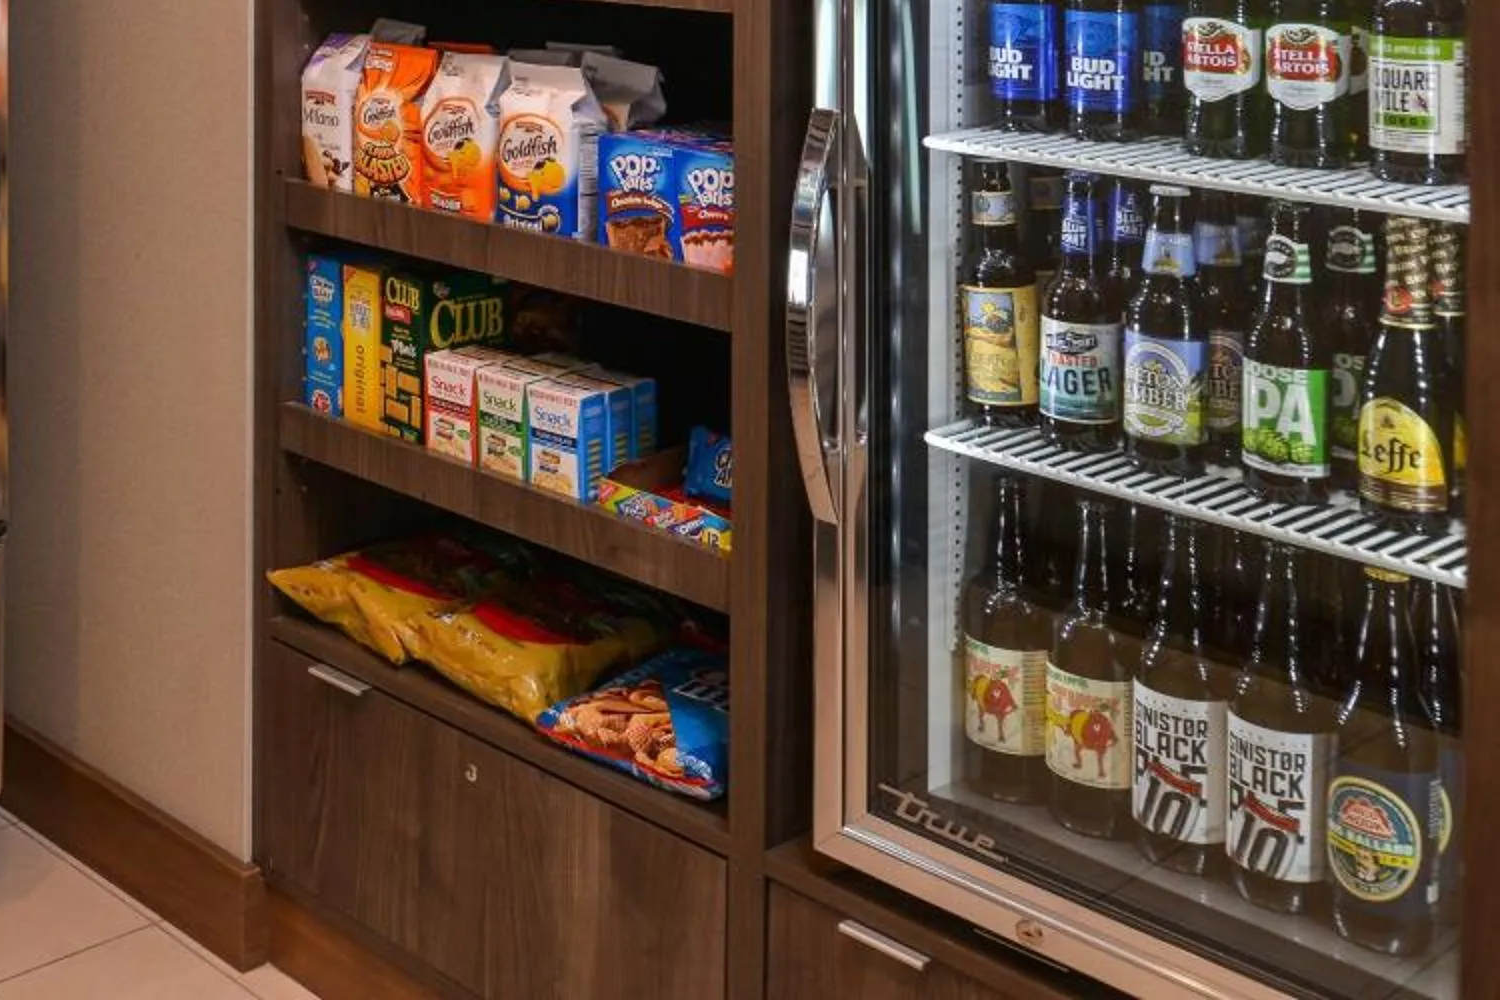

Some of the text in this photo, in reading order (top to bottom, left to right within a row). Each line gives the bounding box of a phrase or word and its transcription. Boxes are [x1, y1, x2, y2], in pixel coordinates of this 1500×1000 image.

[1071, 56, 1116, 73] BUD
[1275, 47, 1329, 64] STELLA
[1276, 61, 1331, 75] ARTOIS
[1067, 72, 1125, 90] LIGHT
[428, 117, 475, 146] Goldfish
[502, 134, 558, 163] Goldfish
[385, 276, 420, 312] CLUB
[429, 297, 504, 349] CLUB
[432, 374, 468, 393] Snack
[1040, 366, 1112, 396] LAGER
[483, 390, 517, 412] Snack
[1245, 376, 1317, 447] PA
[534, 405, 571, 429] Snack
[1361, 430, 1423, 474] Leffe
[1135, 718, 1208, 765] BLACK
[1229, 750, 1306, 801] BLACK
[877, 782, 1009, 864] true
